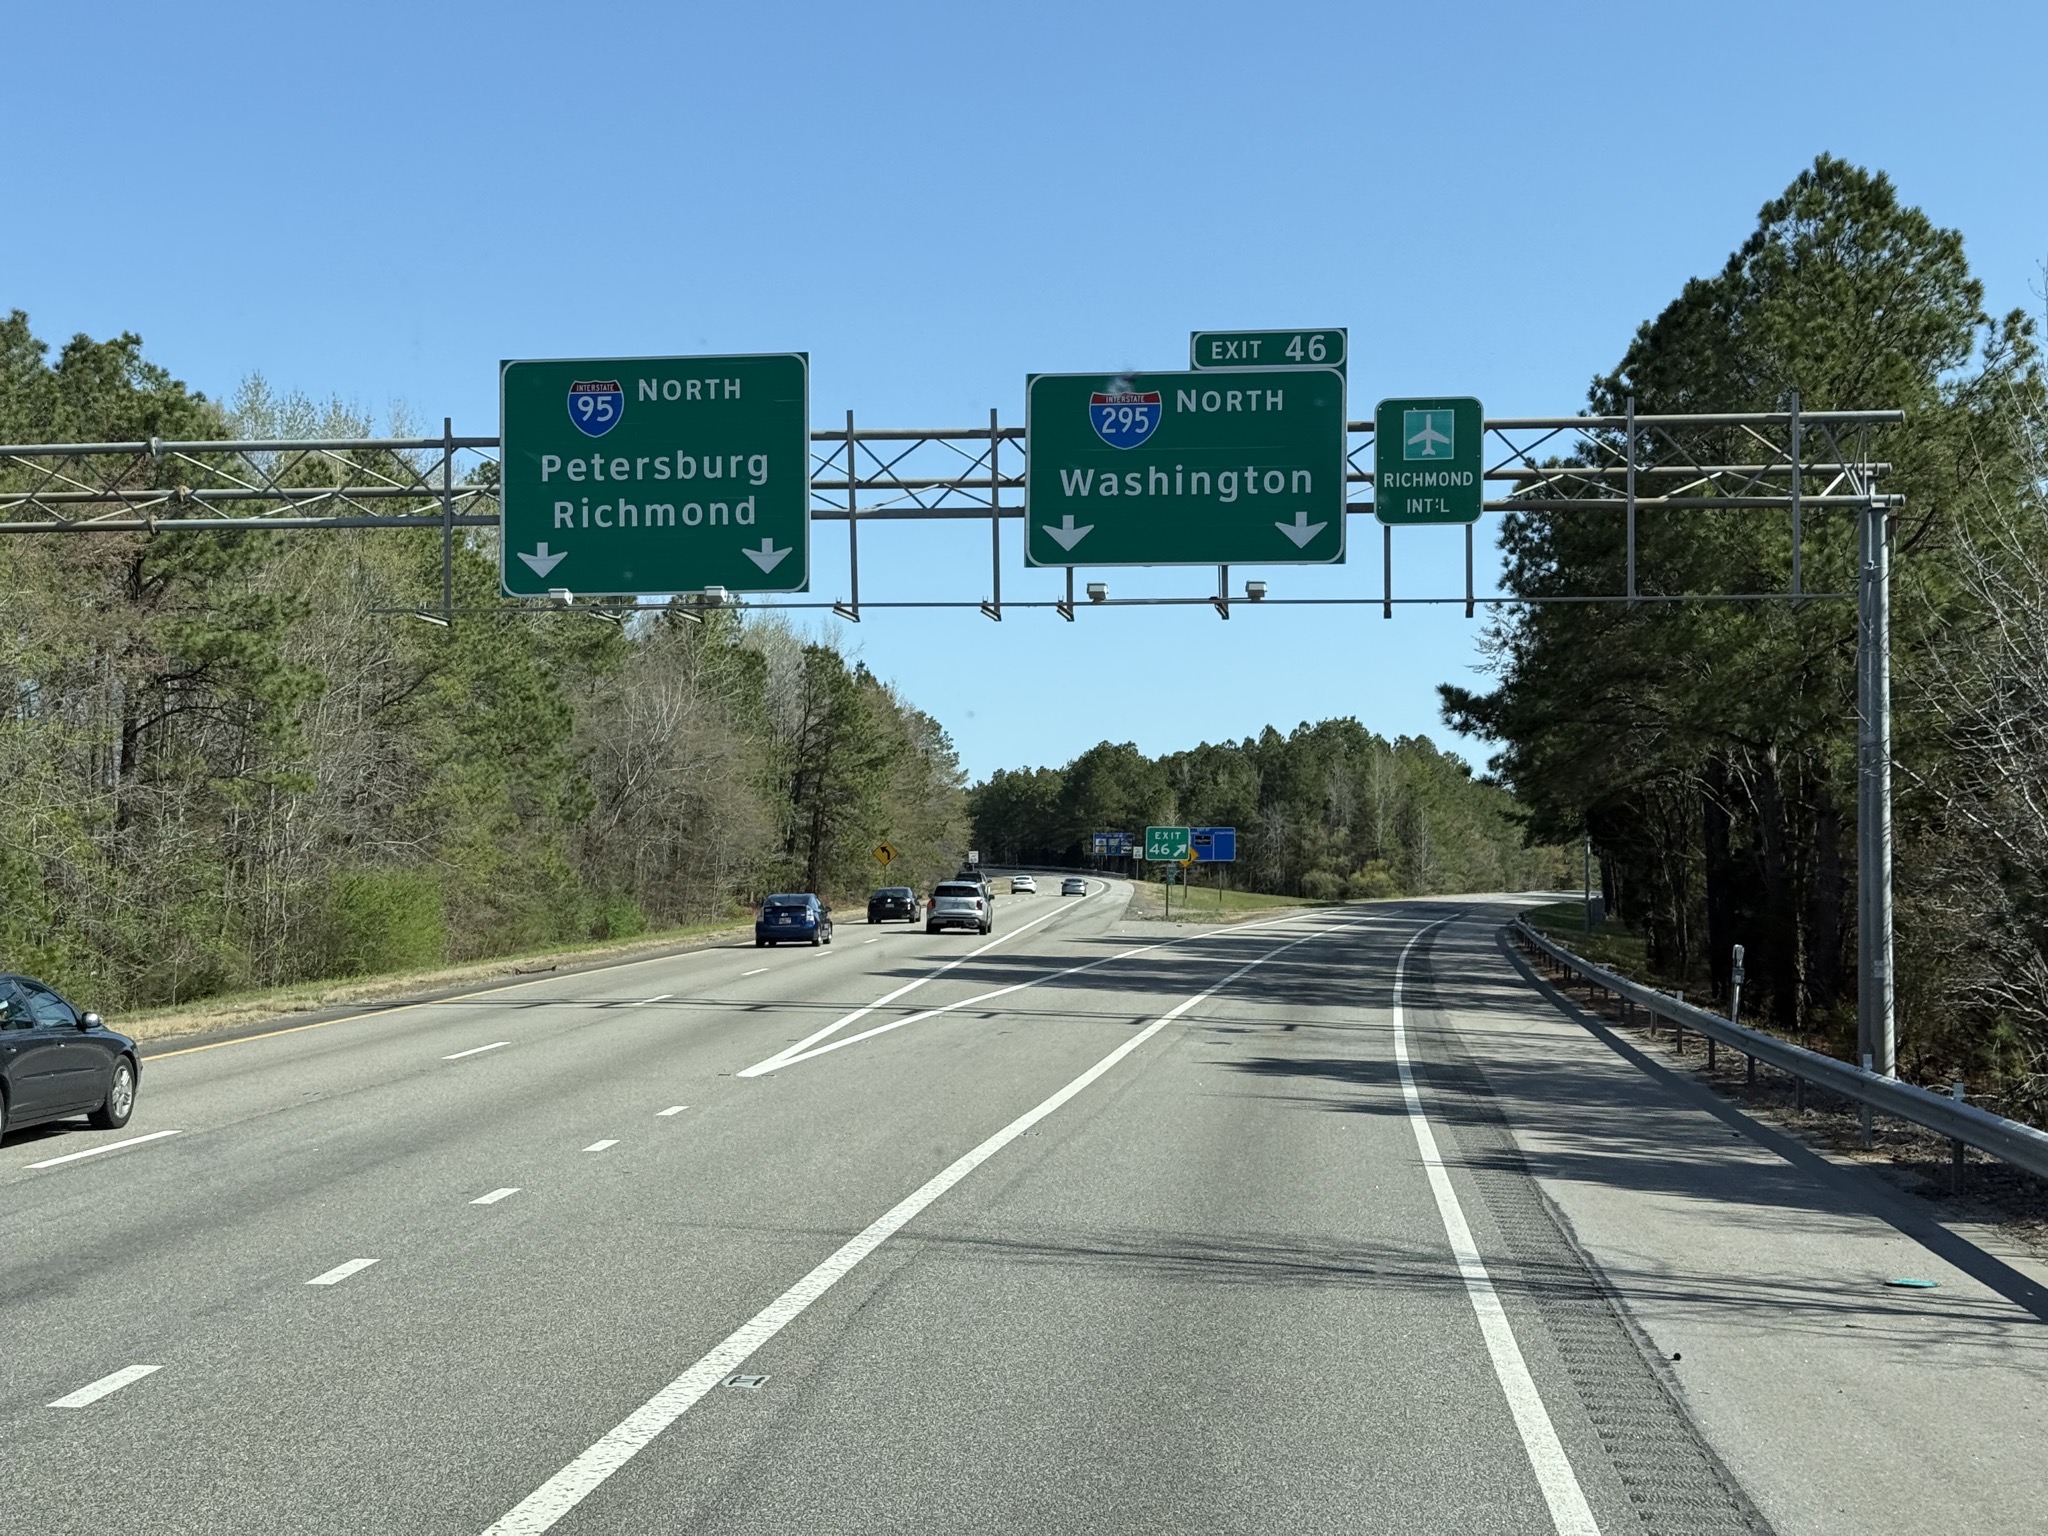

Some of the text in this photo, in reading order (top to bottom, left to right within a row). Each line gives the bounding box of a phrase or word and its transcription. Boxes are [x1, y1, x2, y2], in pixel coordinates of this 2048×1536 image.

[1211, 335, 1327, 362] EXIT 46
[576, 382, 615, 392] INTERSTATE
[638, 378, 741, 402] NORTH
[1105, 395, 1145, 403] INTERSTATE
[577, 396, 614, 422] 95
[1176, 389, 1284, 413] NORTH
[1102, 407, 1149, 433] 295
[541, 450, 768, 486] Petersburg
[1384, 471, 1474, 487] RICHMOND
[1060, 465, 1312, 502] Washington
[554, 495, 755, 529] Richmond
[1407, 498, 1450, 513] INT'L
[1155, 831, 1181, 840] EXIT
[1149, 844, 1170, 855] 46
